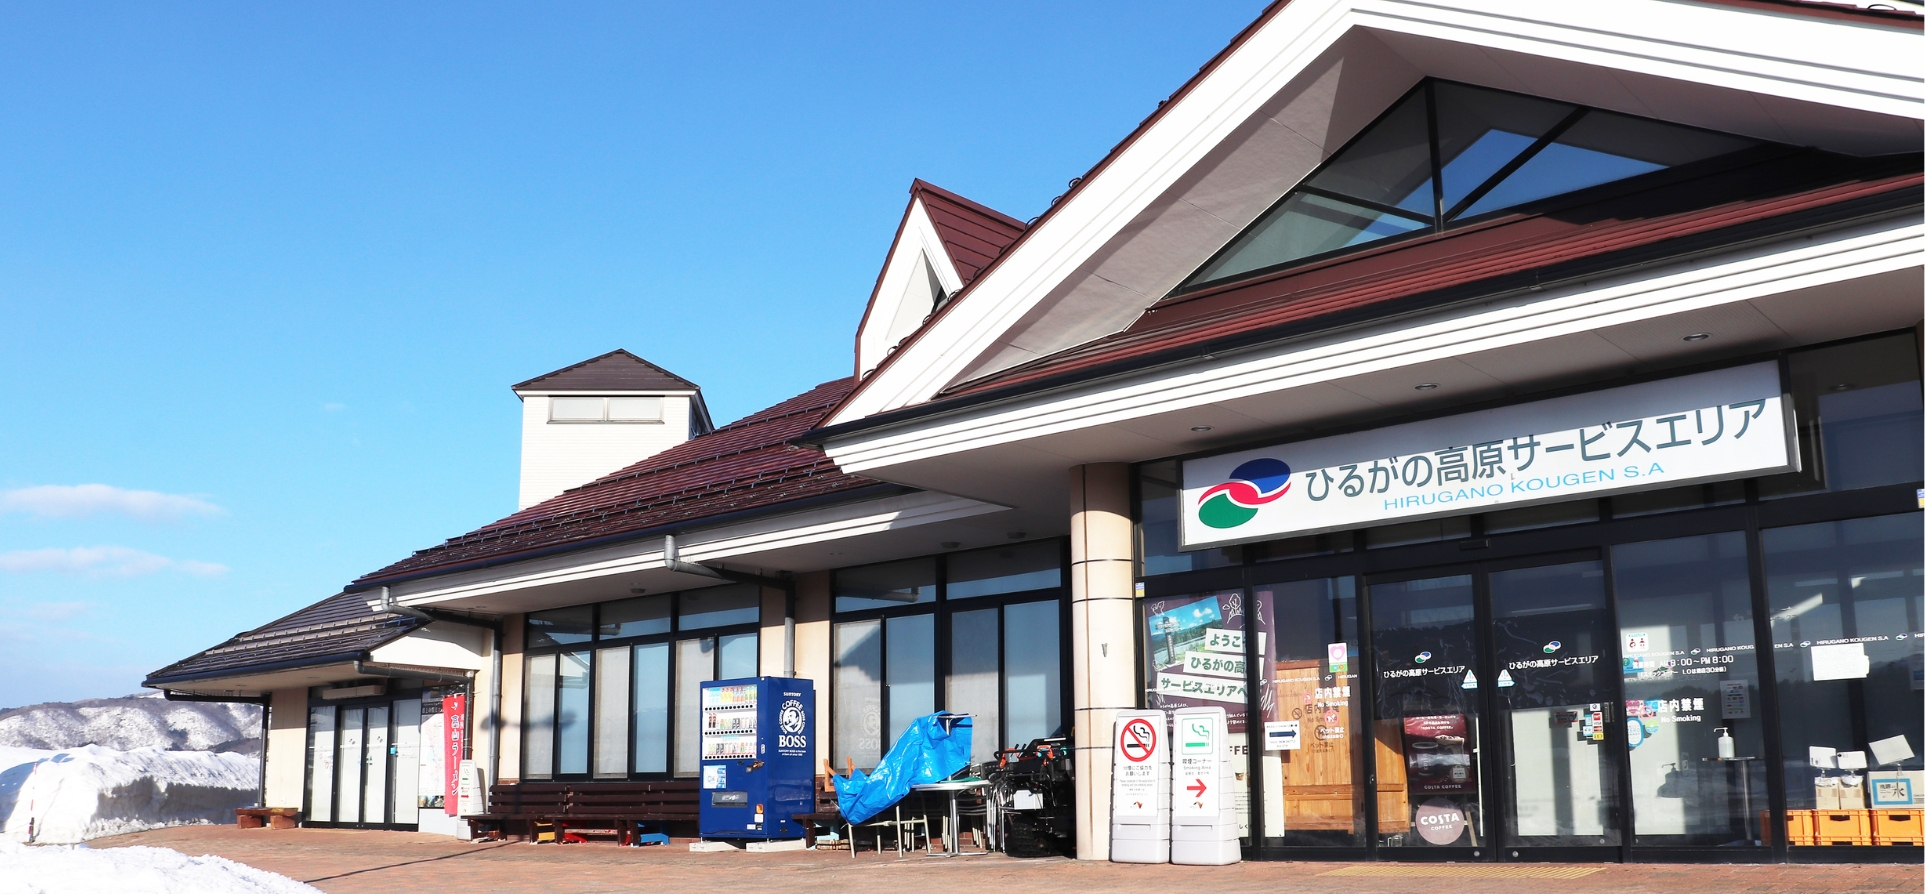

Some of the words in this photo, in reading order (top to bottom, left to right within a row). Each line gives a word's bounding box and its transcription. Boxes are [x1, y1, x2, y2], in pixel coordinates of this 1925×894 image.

[1306, 398, 1766, 501] ひるがの高原サービスエリア
[1384, 484, 1504, 510] HIRUGANO
[1511, 469, 1615, 493] KOUGEN
[1624, 462, 1664, 478] S.A
[1508, 655, 1599, 670] ひるがの高原サービスエリア
[1383, 665, 1465, 679] ひるがの高原サービスエリア
[781, 699, 803, 711] COFFEE
[1672, 715, 1701, 724] Smoking
[778, 735, 807, 748] BOSS
[1420, 812, 1460, 825] COSTA
